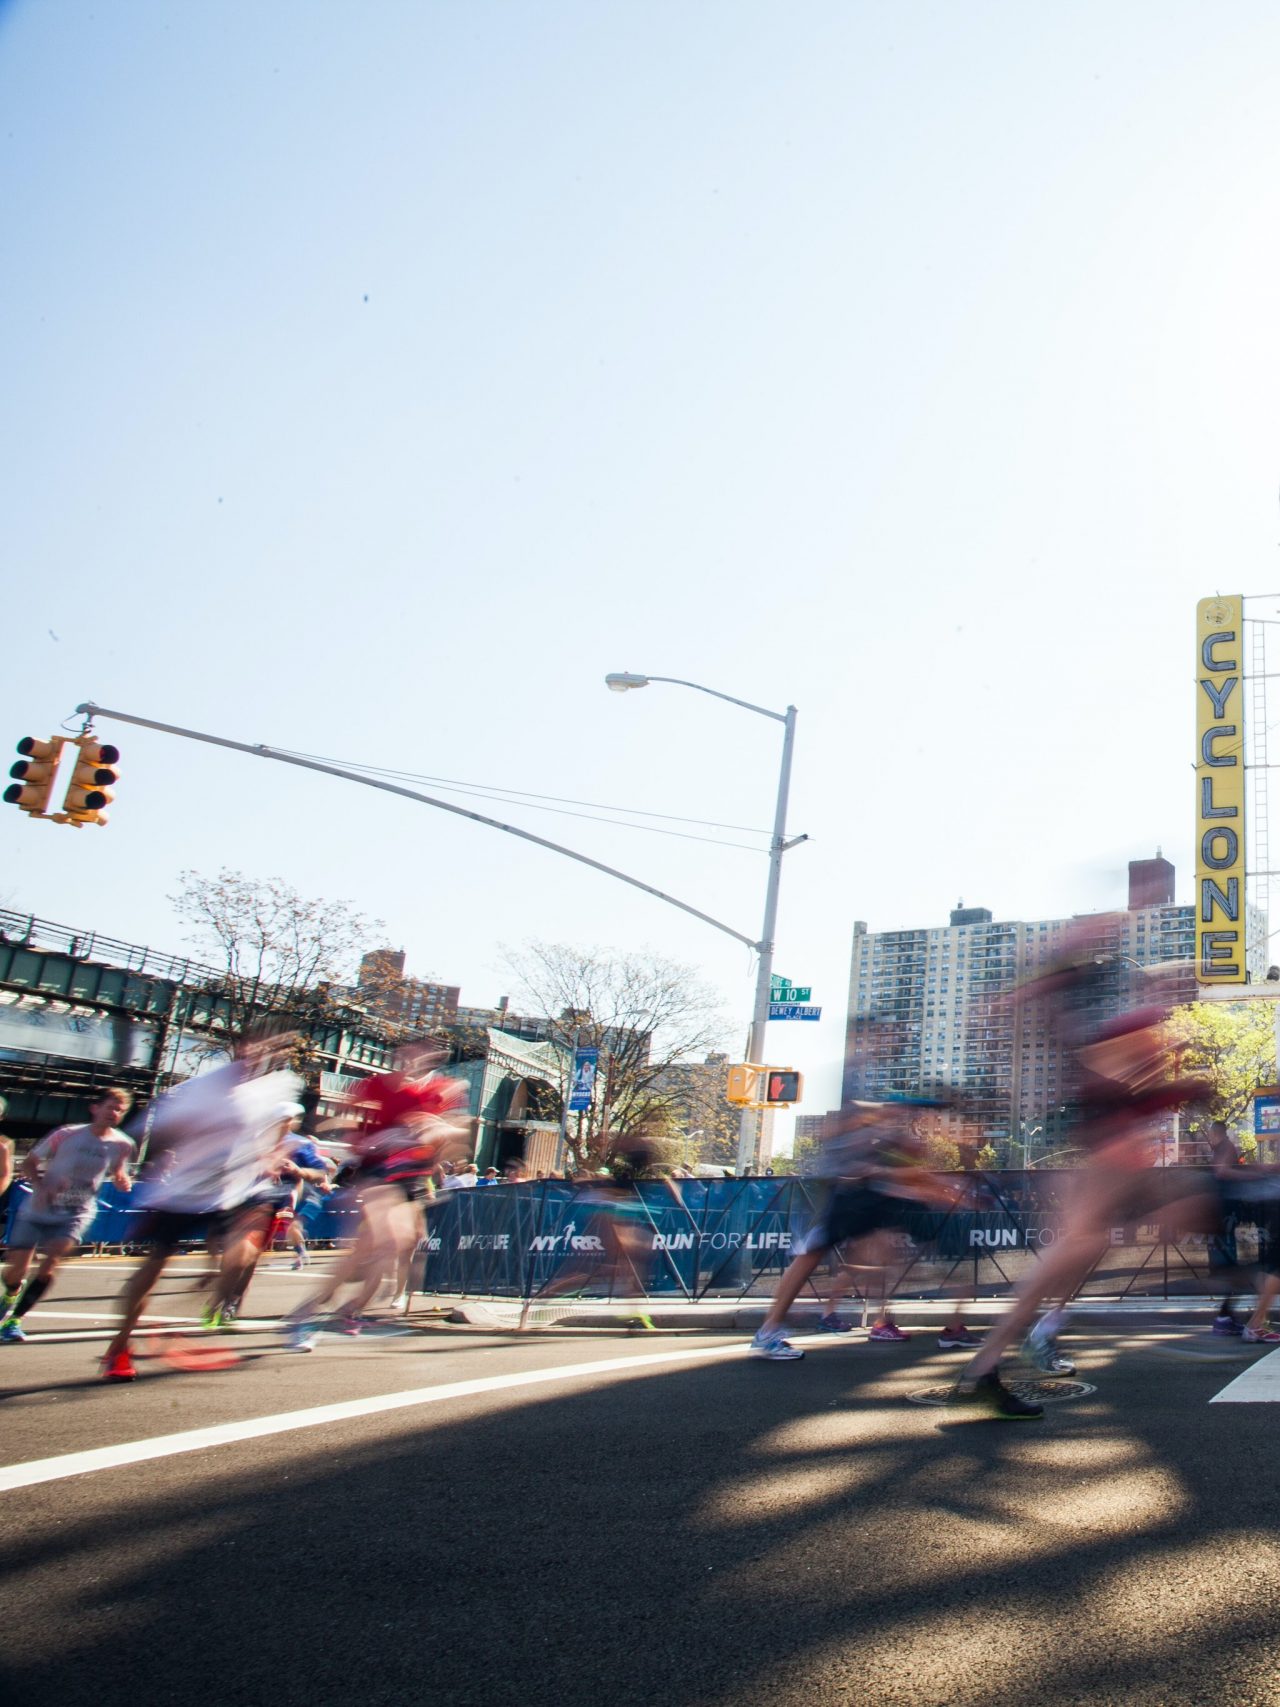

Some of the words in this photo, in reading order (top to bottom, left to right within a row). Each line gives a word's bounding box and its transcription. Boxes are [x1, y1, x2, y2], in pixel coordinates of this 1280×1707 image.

[1200, 630, 1239, 976] CYCLONE
[773, 989, 782, 1001] W
[786, 988, 797, 1001] 10
[771, 1007, 793, 1015] DEWEY
[795, 1007, 821, 1015] ALBERT
[457, 1234, 475, 1250] RUN
[473, 1235, 493, 1250] FOR
[493, 1233, 510, 1250] LIFE
[651, 1232, 695, 1250] RUN
[698, 1232, 742, 1249] FOR
[746, 1232, 792, 1249] LIFE
[969, 1228, 1017, 1246] RUN
